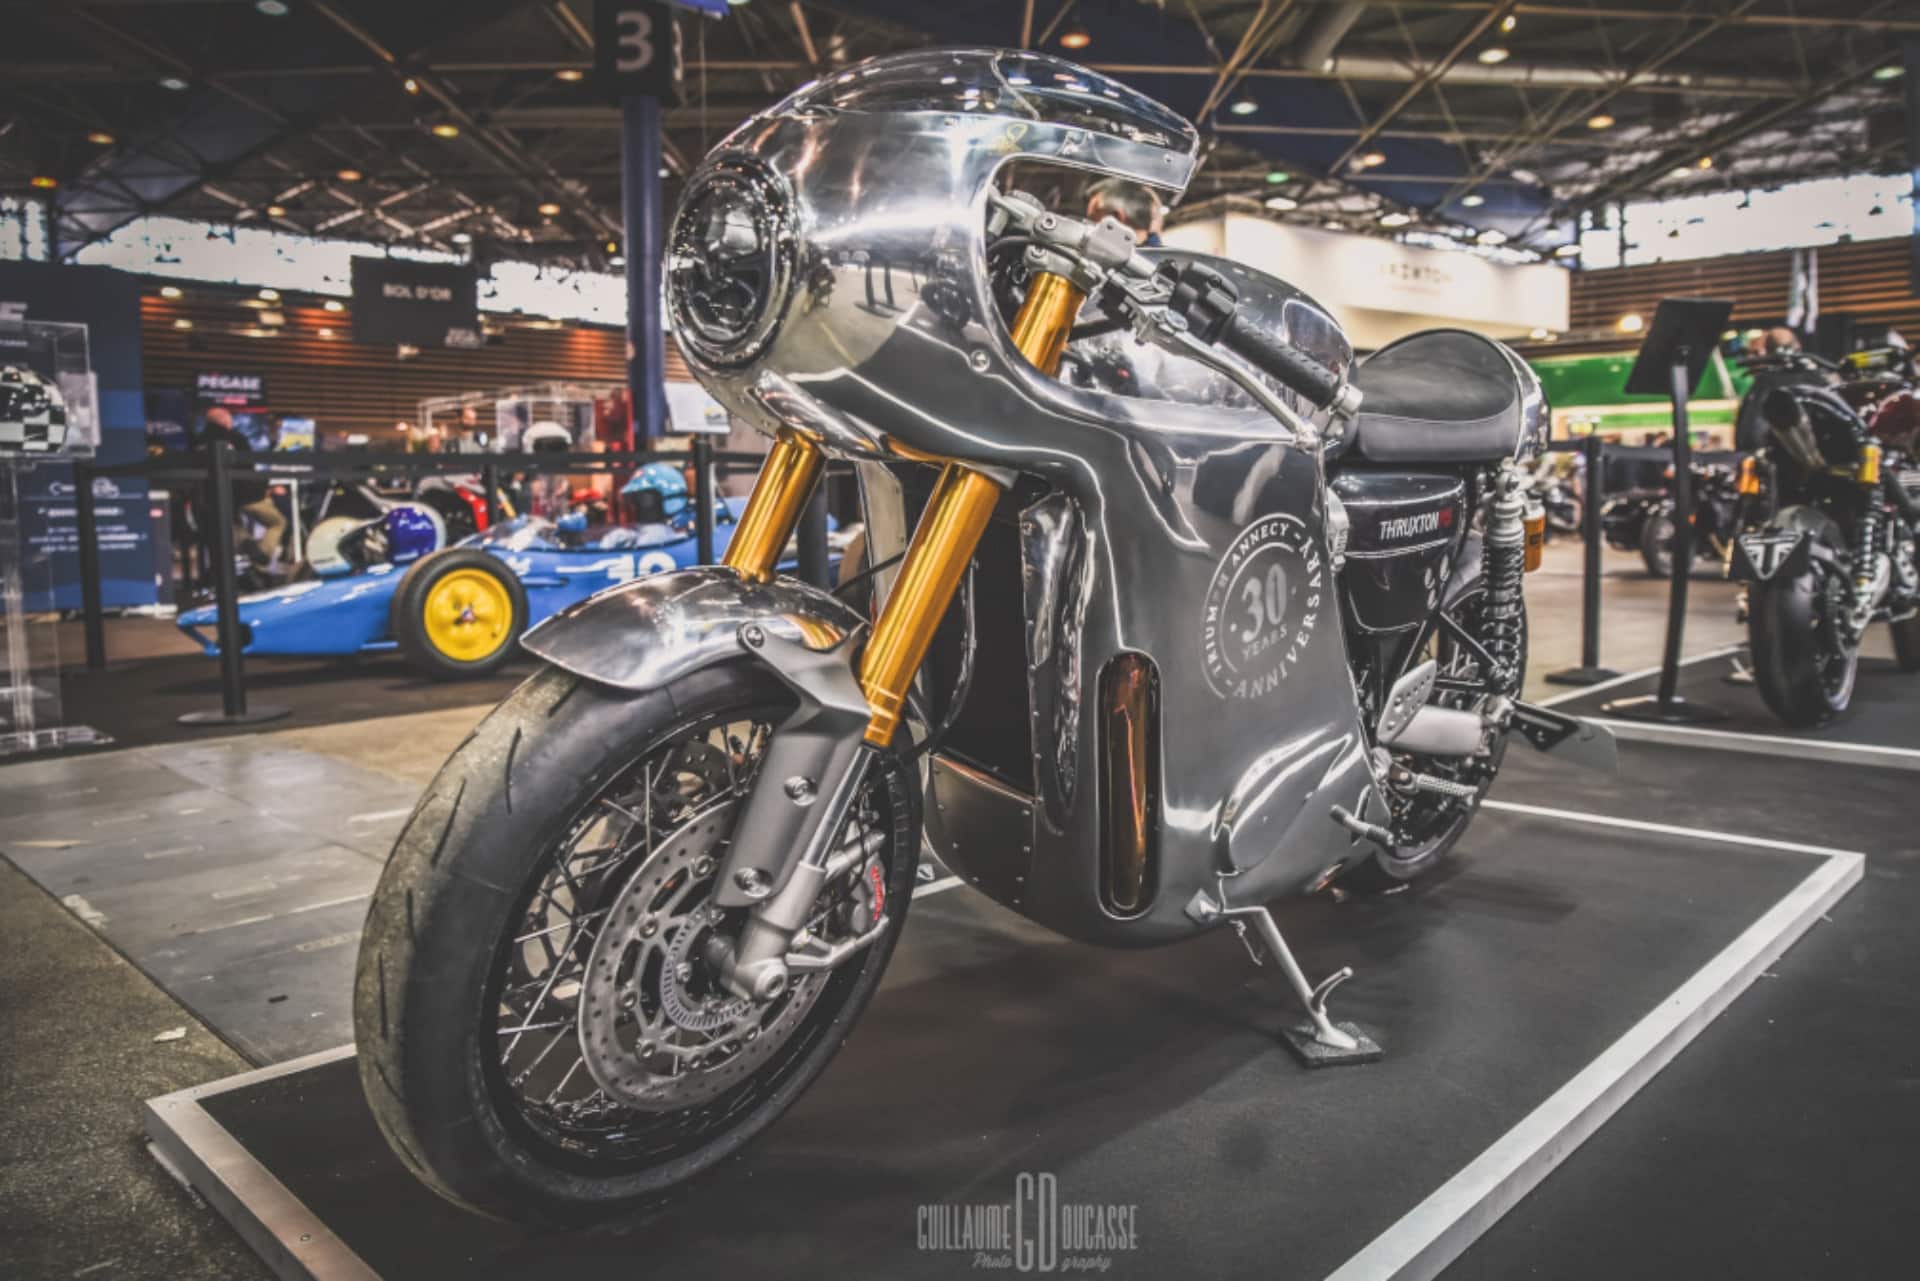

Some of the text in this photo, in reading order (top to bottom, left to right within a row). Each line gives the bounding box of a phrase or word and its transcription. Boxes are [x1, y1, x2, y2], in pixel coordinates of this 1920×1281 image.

[616, 10, 653, 72] 3
[1379, 511, 1440, 541] THRUXTON
[1204, 521, 1290, 677] TRIUMH ANNECY
[1232, 536, 1322, 699] ANNIVERSARY
[1241, 563, 1288, 643] 30
[1242, 624, 1288, 662] YEARS
